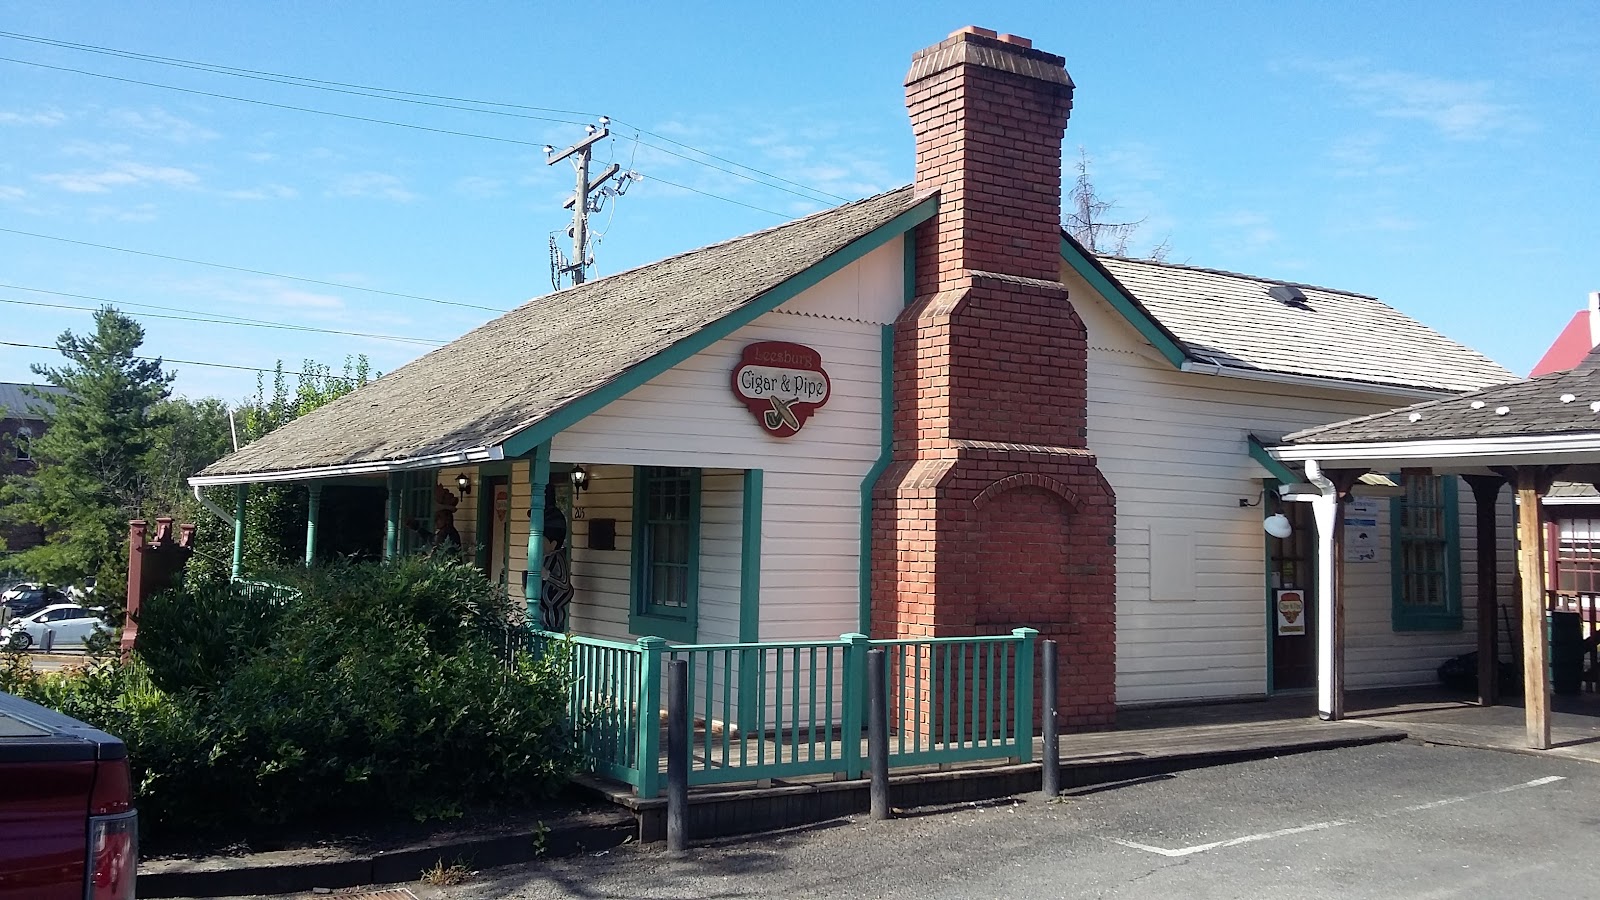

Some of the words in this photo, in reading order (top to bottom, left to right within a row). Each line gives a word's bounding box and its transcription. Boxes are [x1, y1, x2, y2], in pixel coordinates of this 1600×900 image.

[754, 347, 813, 368] Leesburg
[741, 370, 777, 395] Cigar
[780, 374, 791, 392] &
[794, 375, 824, 398] Pipe
